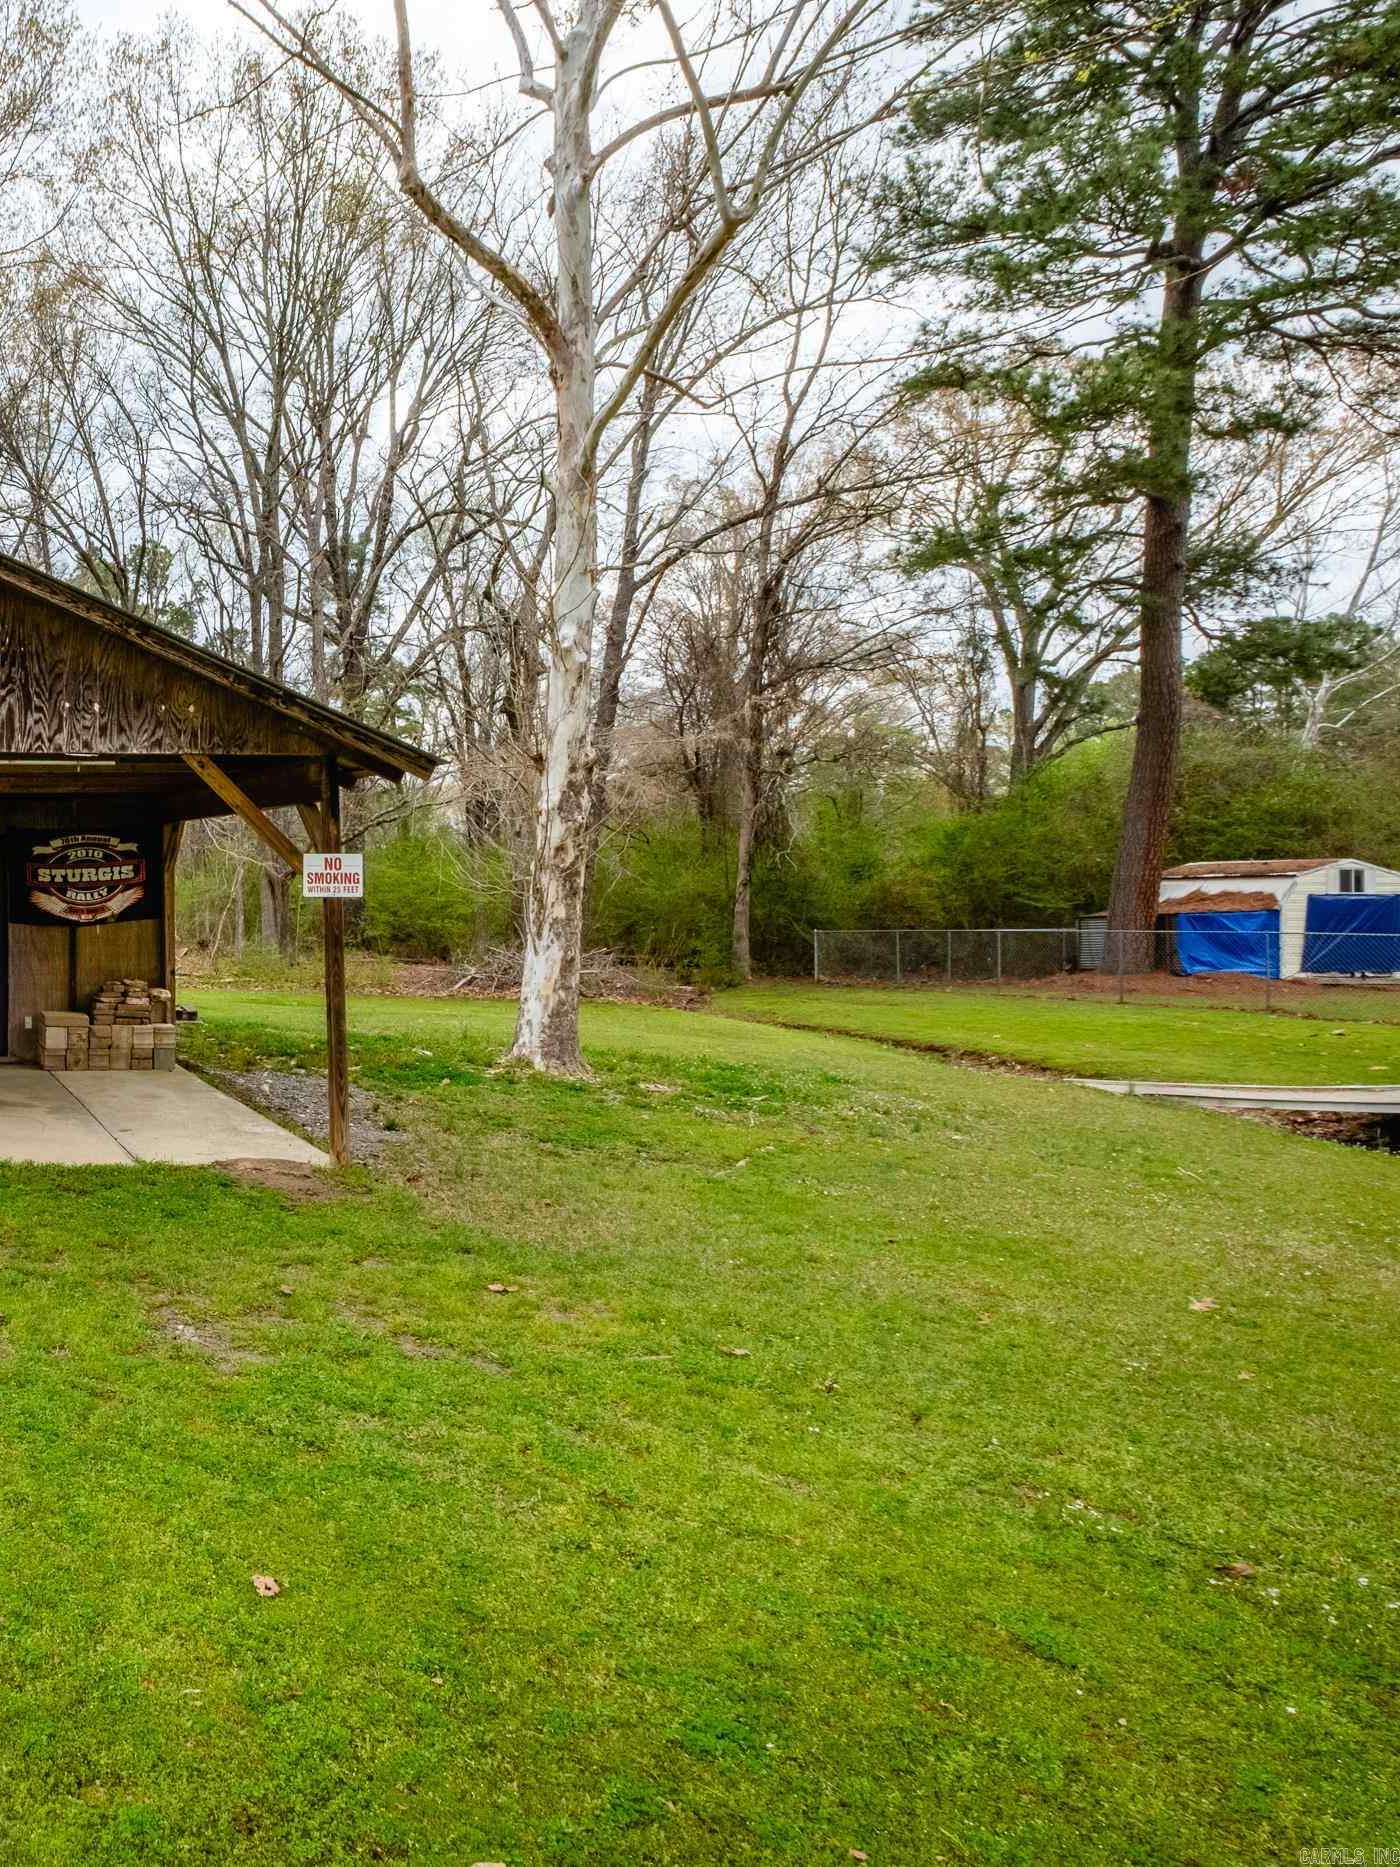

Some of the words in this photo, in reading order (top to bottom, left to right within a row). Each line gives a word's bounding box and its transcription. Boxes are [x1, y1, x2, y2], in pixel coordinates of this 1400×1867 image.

[67, 849, 104, 859] 2010
[324, 856, 342, 871] NO
[38, 865, 134, 882] STURGIS
[307, 871, 360, 885] SMOKING
[66, 886, 108, 901] RALLY
[307, 885, 331, 893] WITHIN
[343, 885, 359, 893] FEET
